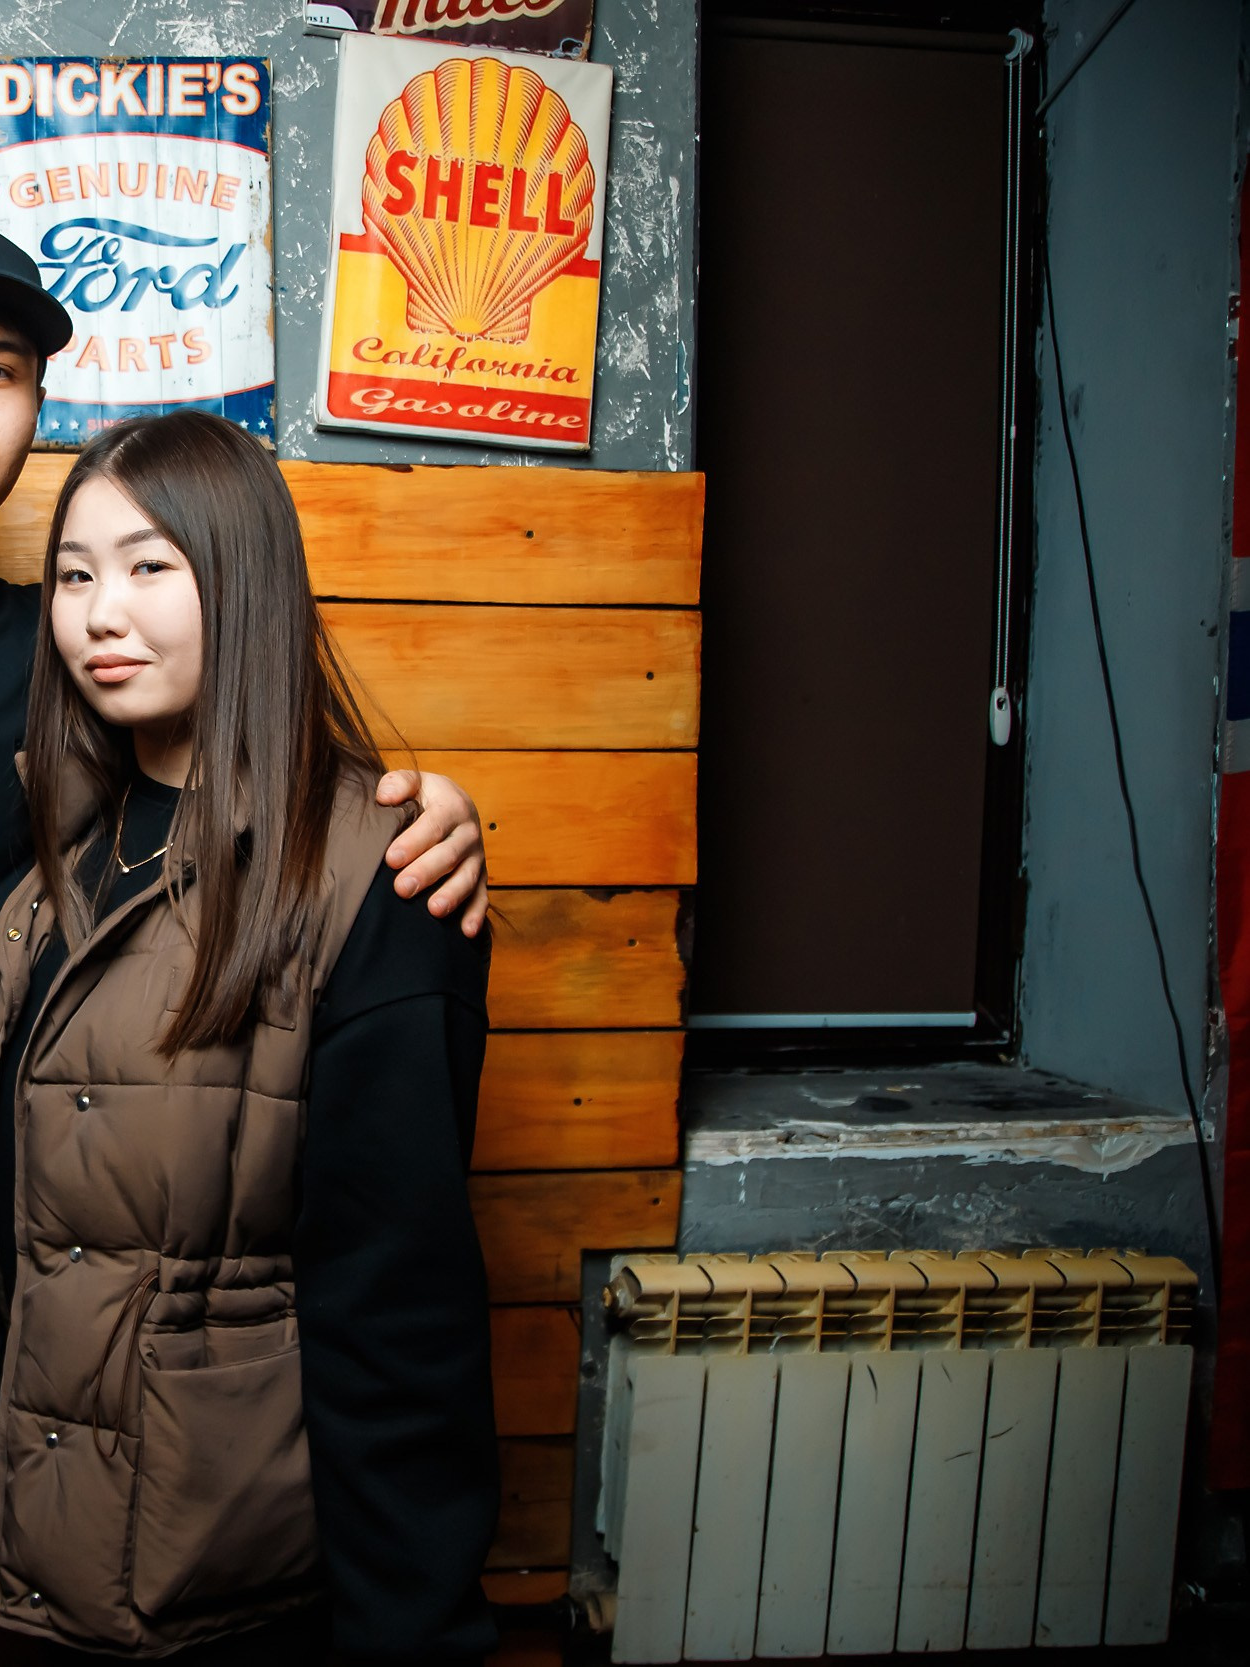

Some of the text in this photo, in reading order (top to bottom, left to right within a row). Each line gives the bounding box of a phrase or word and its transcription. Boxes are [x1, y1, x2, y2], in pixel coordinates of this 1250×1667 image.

[8, 162, 242, 212] GENUINE
[381, 150, 576, 237] SHELL
[38, 217, 247, 313] Ford
[352, 337, 581, 384] California
[350, 388, 585, 429] Gasoline
